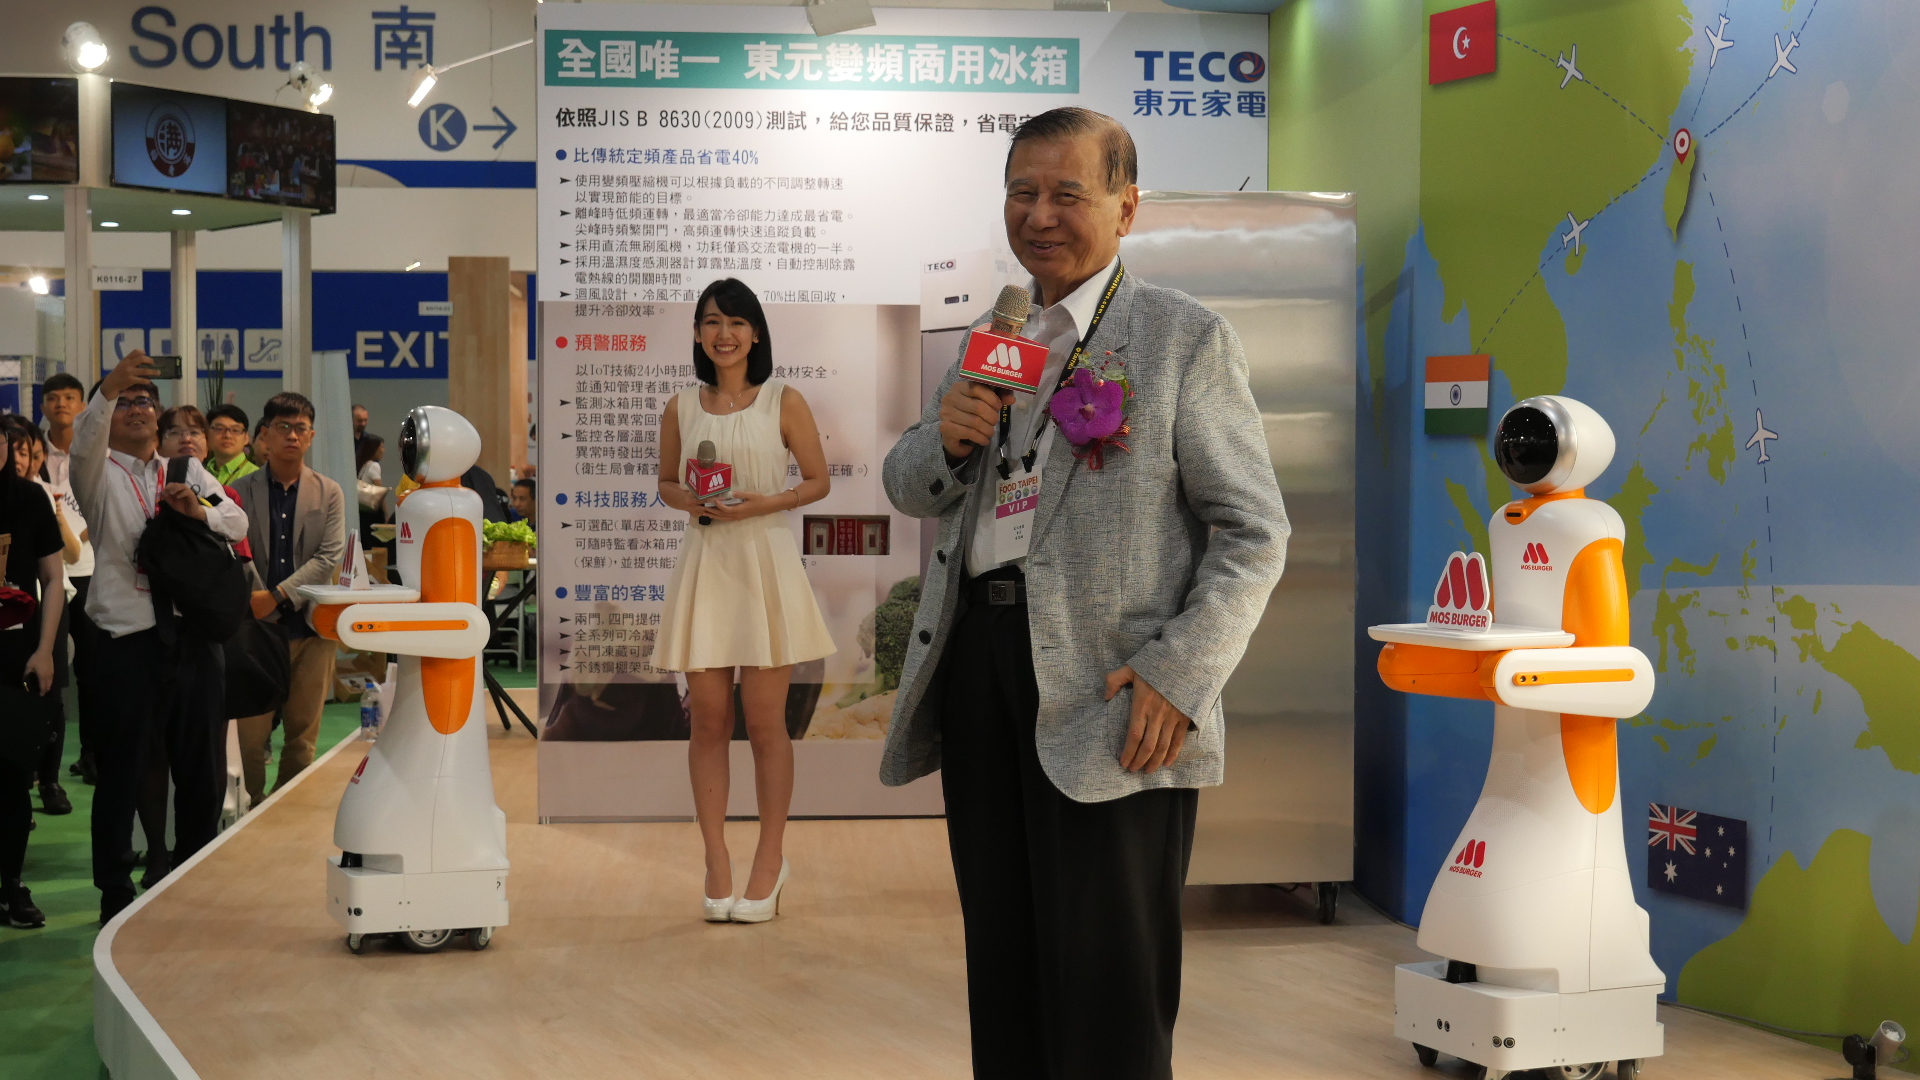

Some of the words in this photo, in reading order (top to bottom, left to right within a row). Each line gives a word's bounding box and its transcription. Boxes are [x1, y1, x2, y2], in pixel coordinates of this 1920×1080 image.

[129, 6, 332, 71] South
[372, 5, 436, 71] 南
[557, 38, 721, 80] 全國唯一
[743, 40, 1068, 86] 東元變頻商用冰箱
[1134, 50, 1266, 84] TECO
[1133, 88, 1266, 118] 東元家電
[429, 109, 457, 146] K
[573, 147, 759, 166] 比傳統定頻產品省電40%
[575, 191, 693, 205] 以實現節能的目標。
[927, 260, 955, 272] TECO
[96, 275, 138, 284] K0116-27
[575, 287, 704, 302] 迴風設計，冷風不直
[575, 303, 666, 318] 提升冷卻效率。
[575, 333, 647, 352] 預警服務
[981, 363, 997, 373] MOS
[997, 367, 1023, 379] BURGER
[575, 445, 661, 459] 異常時發出失
[1000, 482, 1017, 494] FOOD
[1018, 475, 1038, 489] TAIPEI
[1008, 500, 1028, 513] VIP
[575, 519, 690, 532] 可選配(單店及連鎖
[575, 537, 683, 551] 可隨時監看冰箱用
[574, 584, 666, 602] 豐富的客製
[1429, 611, 1450, 625] MOS
[1451, 612, 1487, 629] BURGER
[574, 628, 659, 642] 全系列可冷凝
[1460, 867, 1483, 878] BURGER
